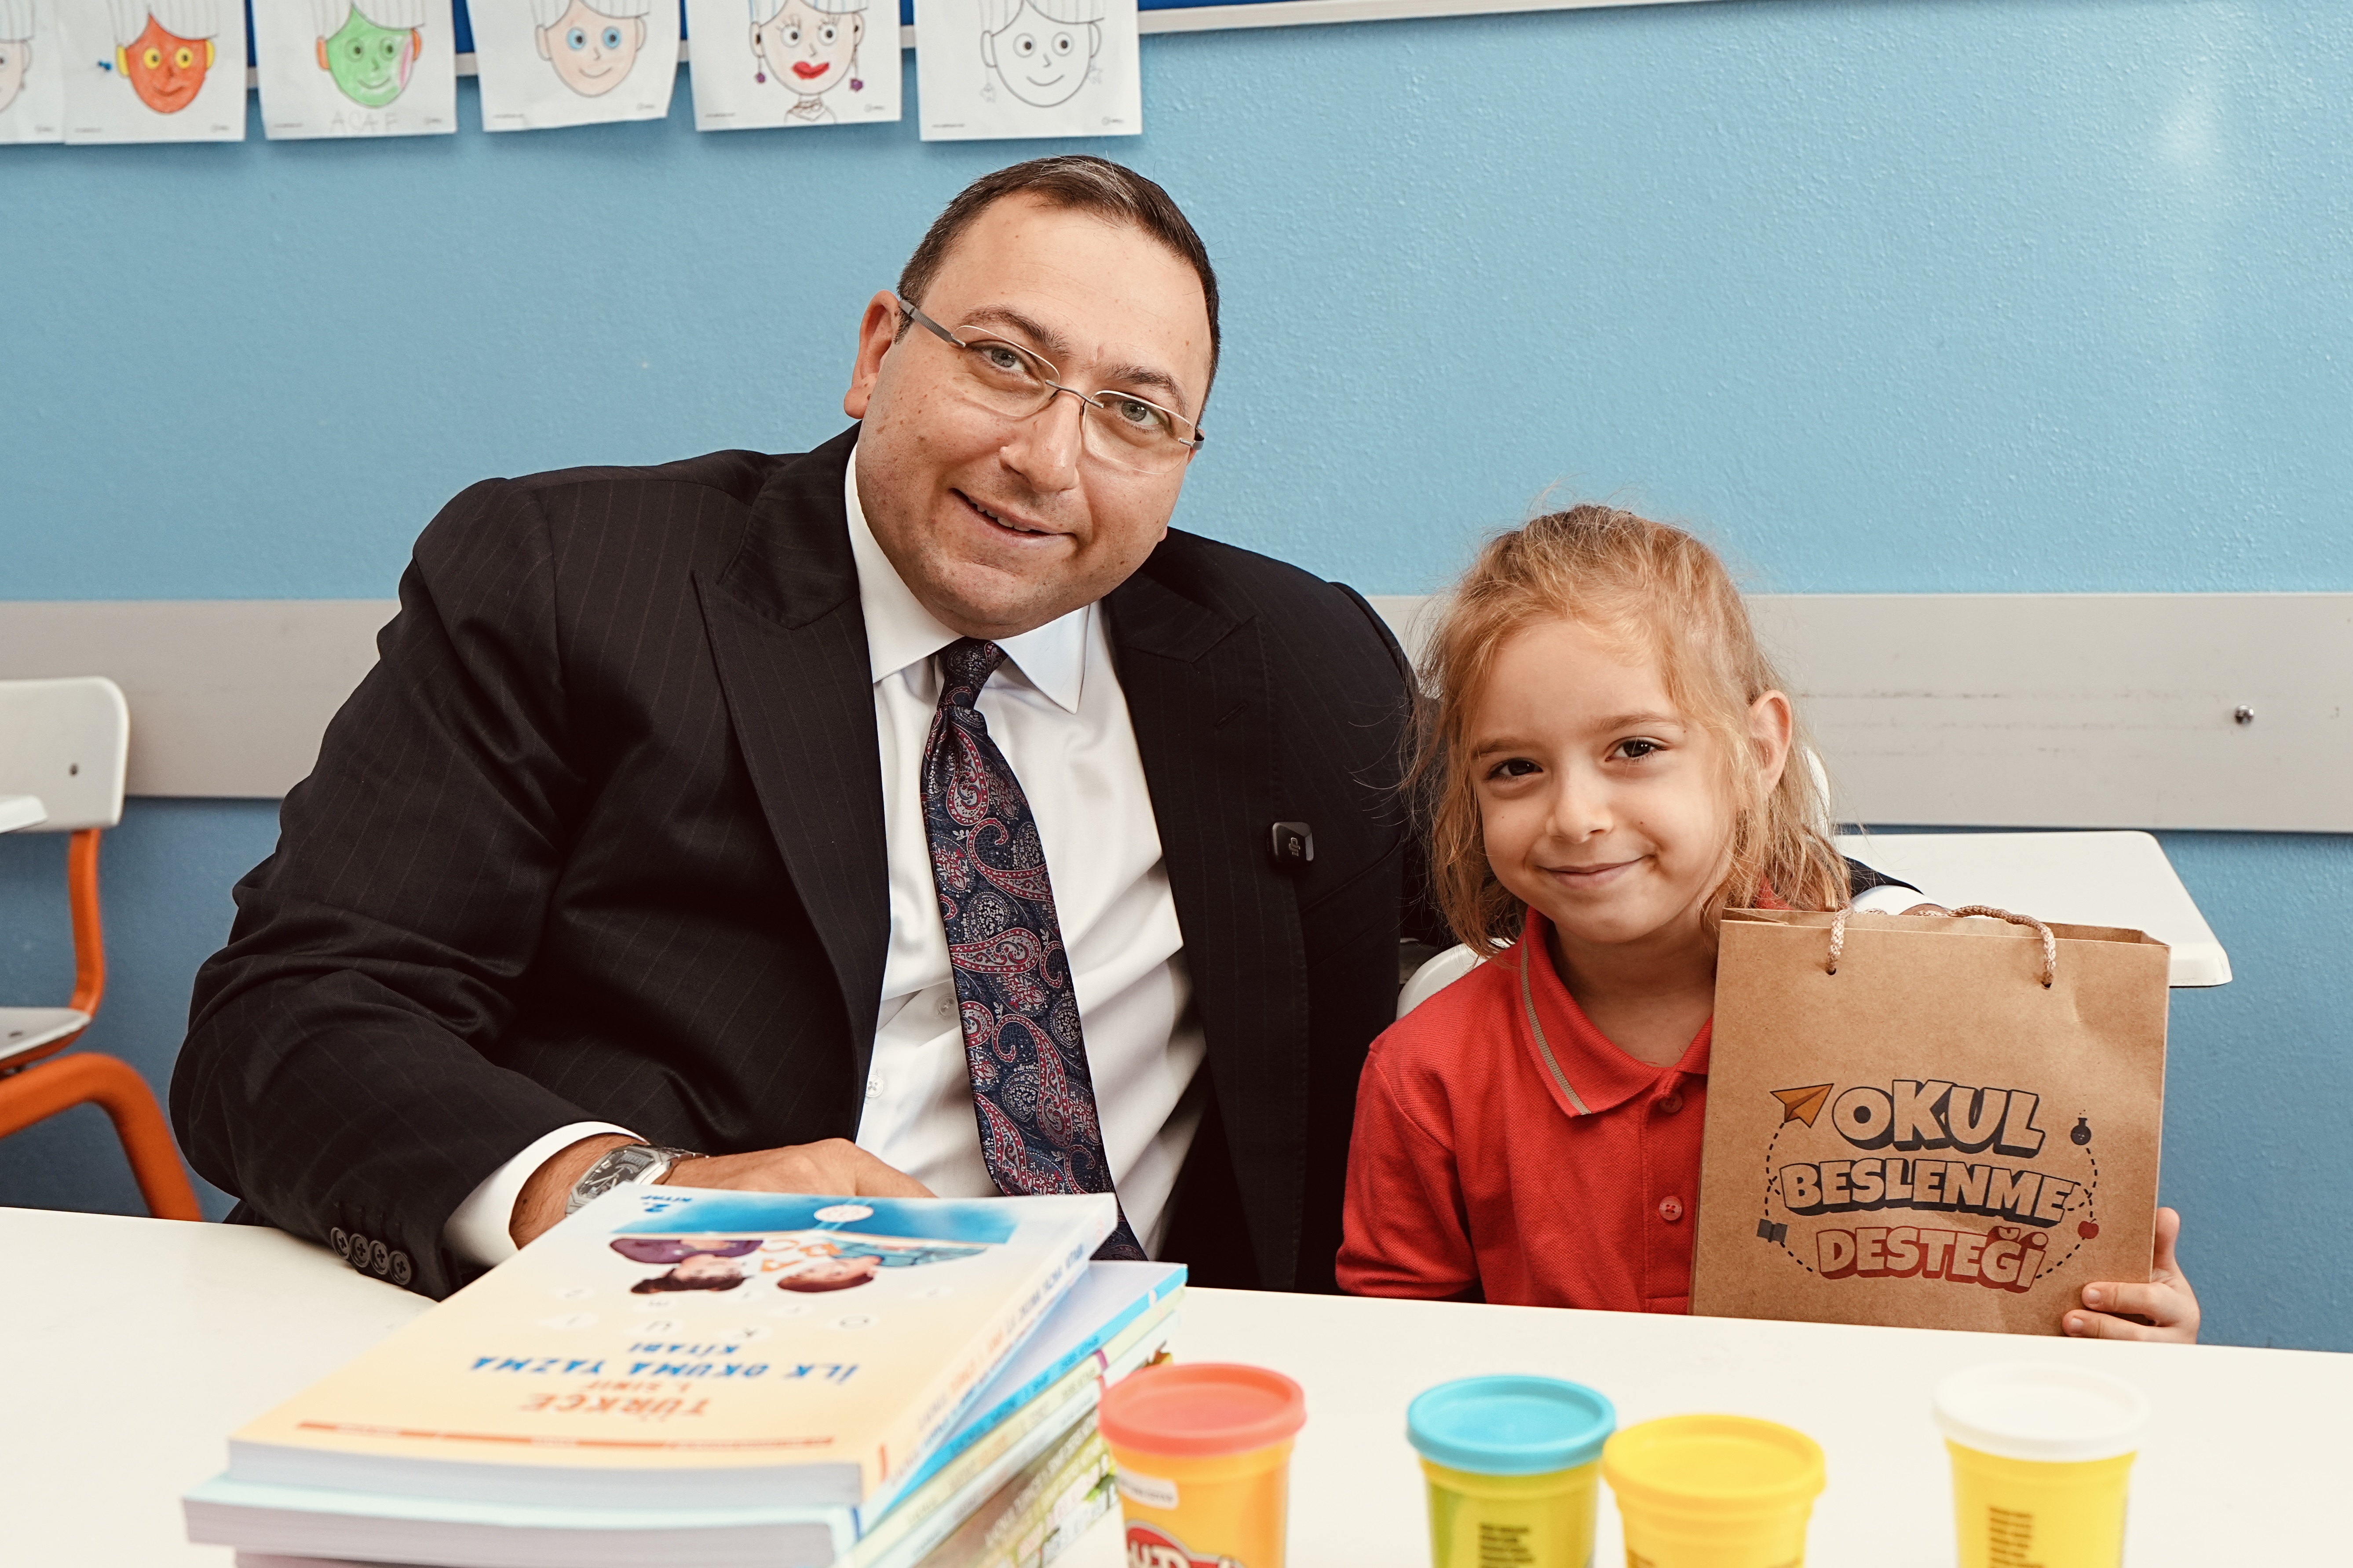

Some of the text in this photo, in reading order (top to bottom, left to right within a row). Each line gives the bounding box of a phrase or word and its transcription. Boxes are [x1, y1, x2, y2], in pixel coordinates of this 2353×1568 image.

[1832, 1079, 2046, 1158] OKUL
[1779, 1157, 2076, 1228] BESLENME
[1816, 1225, 2049, 1294] DESTEĞİ
[470, 1355, 859, 1385] İLK OKUMA YAZMA
[627, 1342, 741, 1358] KİTABI
